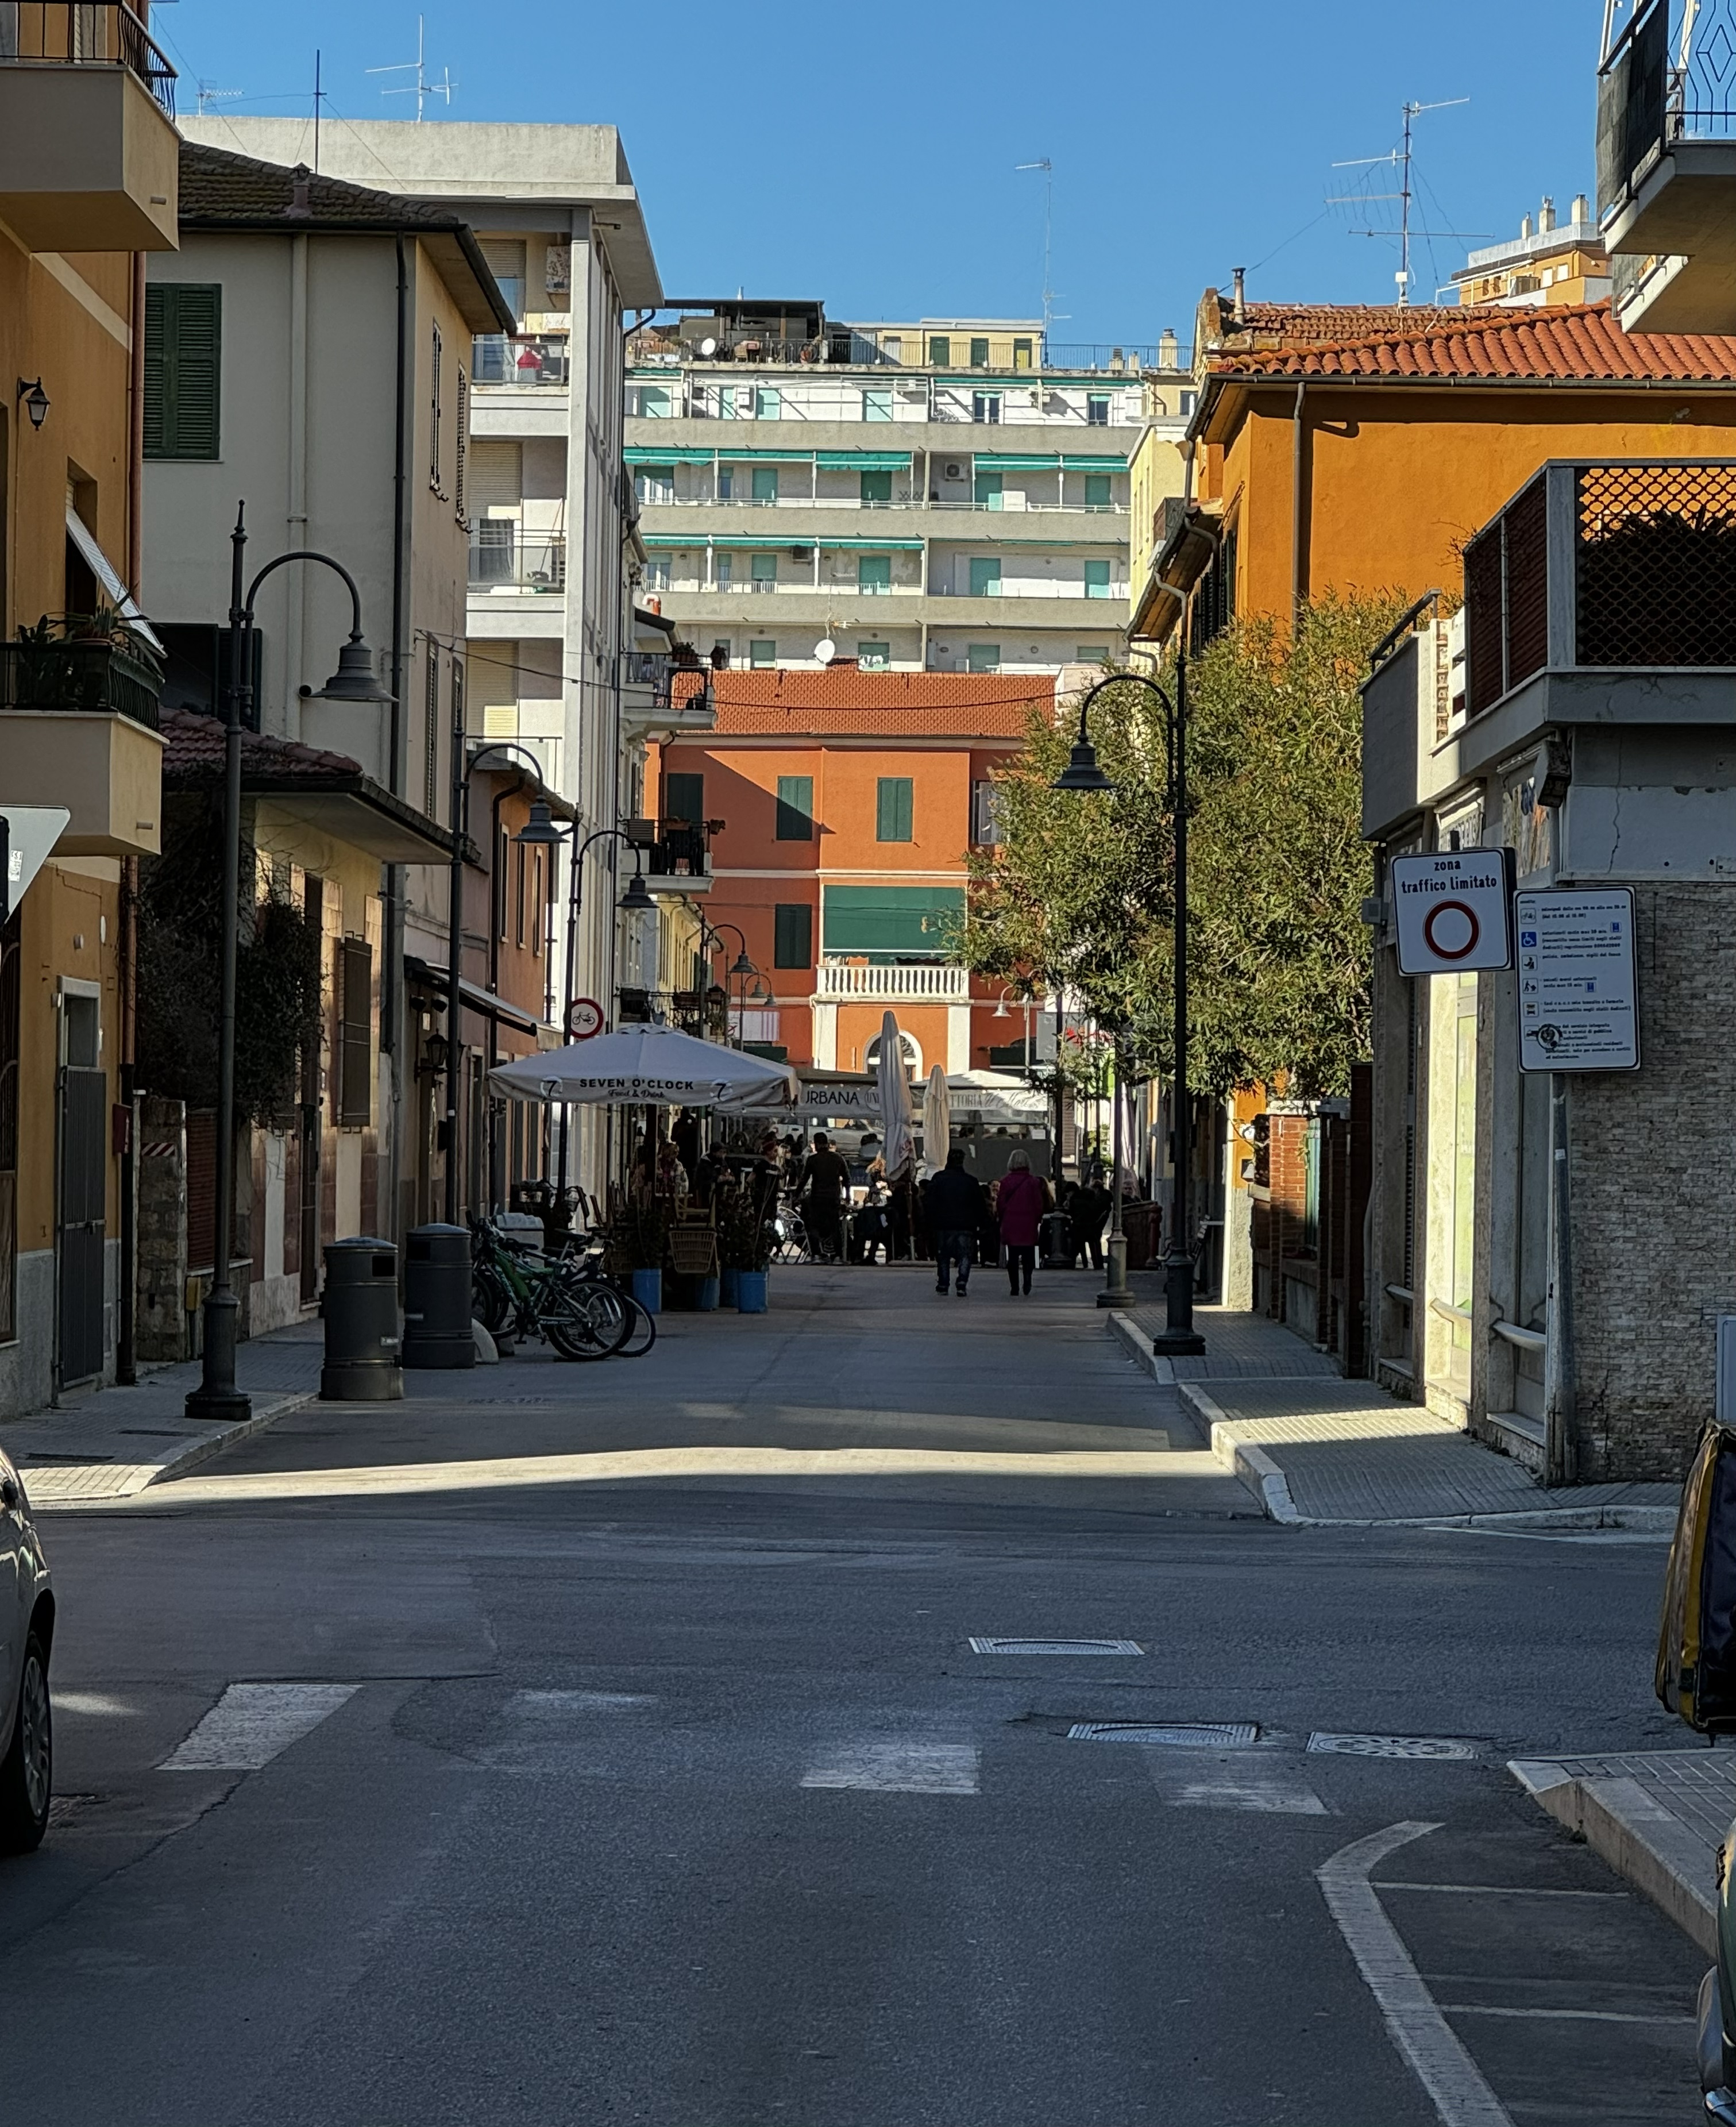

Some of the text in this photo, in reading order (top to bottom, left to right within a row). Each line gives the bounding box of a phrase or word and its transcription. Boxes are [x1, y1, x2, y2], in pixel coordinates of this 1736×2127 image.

[1434, 860, 1461, 871] zona
[1401, 874, 1497, 893] traffico limitato
[546, 1080, 558, 1097] 7
[579, 1078, 694, 1090] SEVEN O'CLOCK
[714, 1083, 727, 1099] 7
[632, 1089, 639, 1097] &
[641, 1089, 665, 1098] Drink
